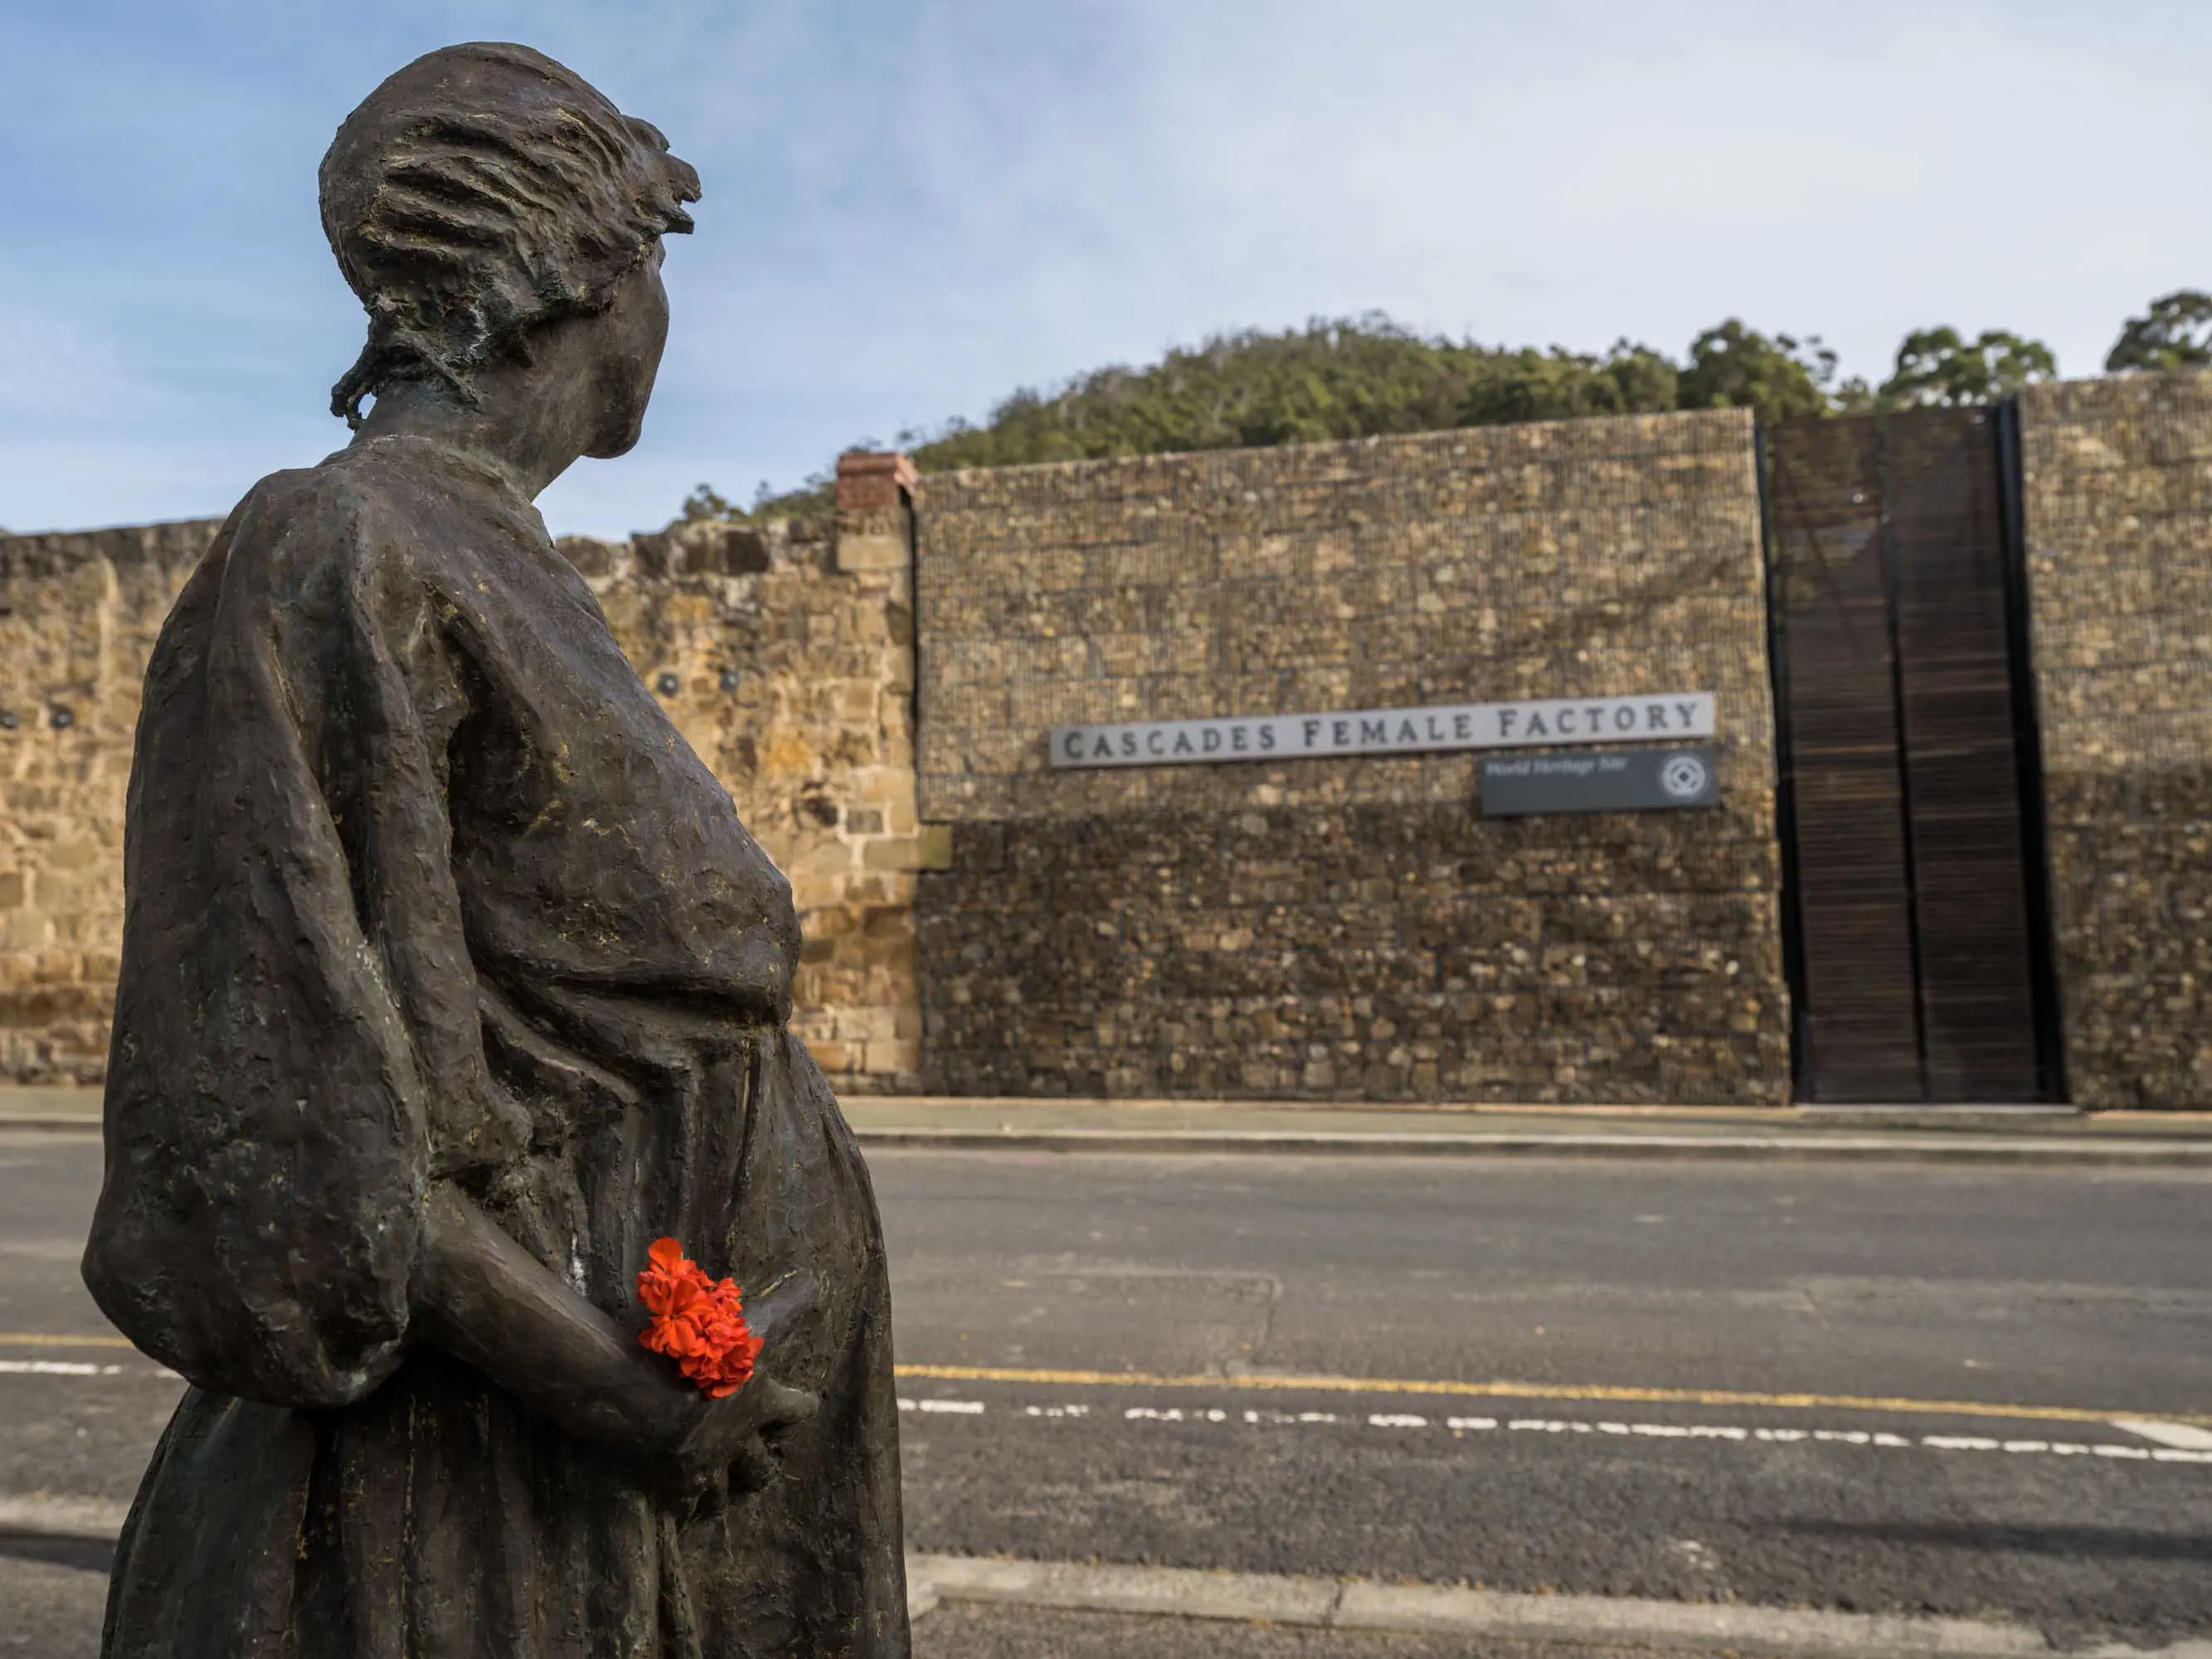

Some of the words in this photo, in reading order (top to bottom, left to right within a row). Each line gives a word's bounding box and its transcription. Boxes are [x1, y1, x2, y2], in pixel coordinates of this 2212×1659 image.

[1063, 723, 1276, 759] CASCADES
[1301, 713, 1473, 748] FEMALE
[1496, 701, 1699, 737] FACTORY
